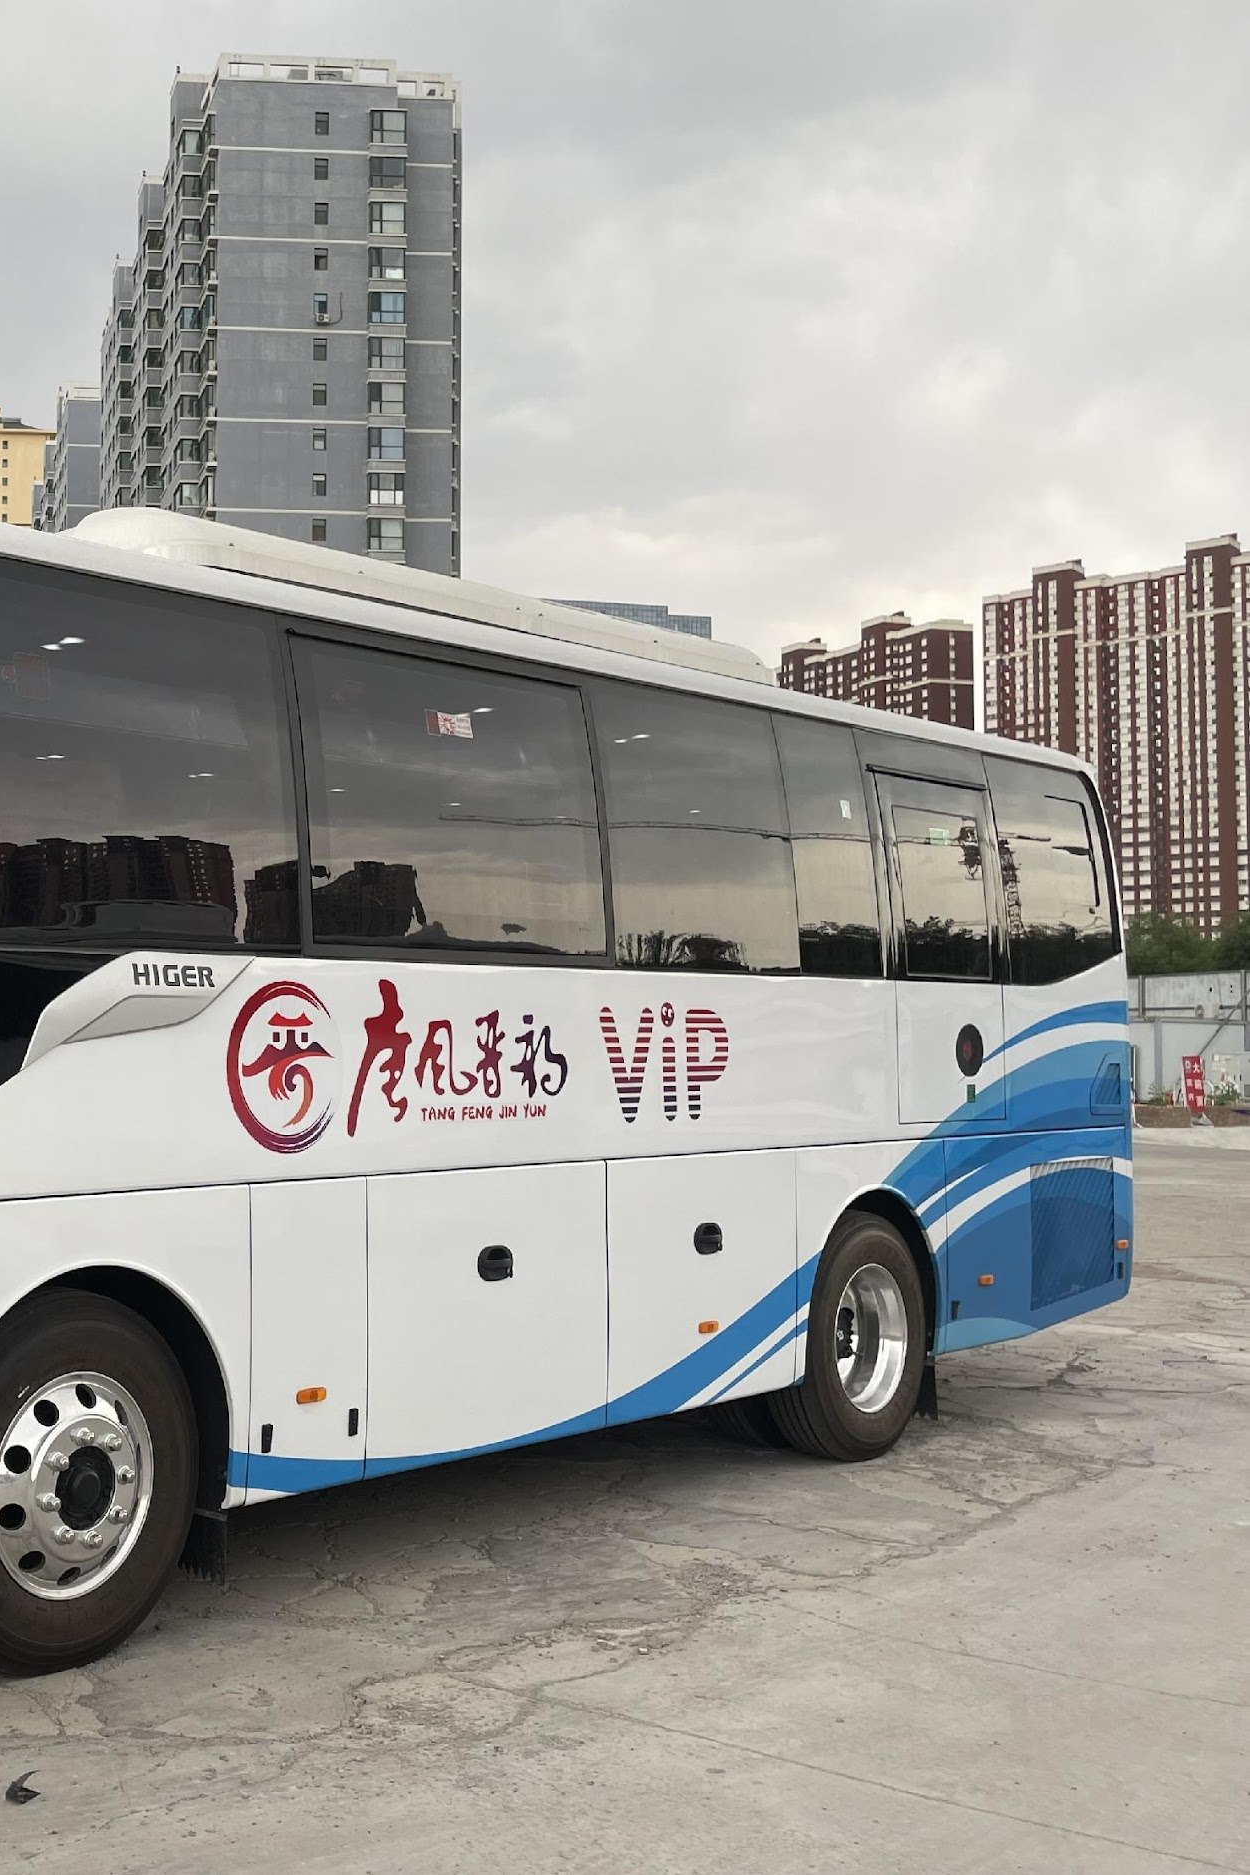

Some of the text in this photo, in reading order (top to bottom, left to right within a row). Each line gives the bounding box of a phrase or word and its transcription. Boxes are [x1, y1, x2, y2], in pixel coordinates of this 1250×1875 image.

[131, 963, 216, 988] HIGER
[421, 1102, 547, 1122] TANG FENG JIN YUN
